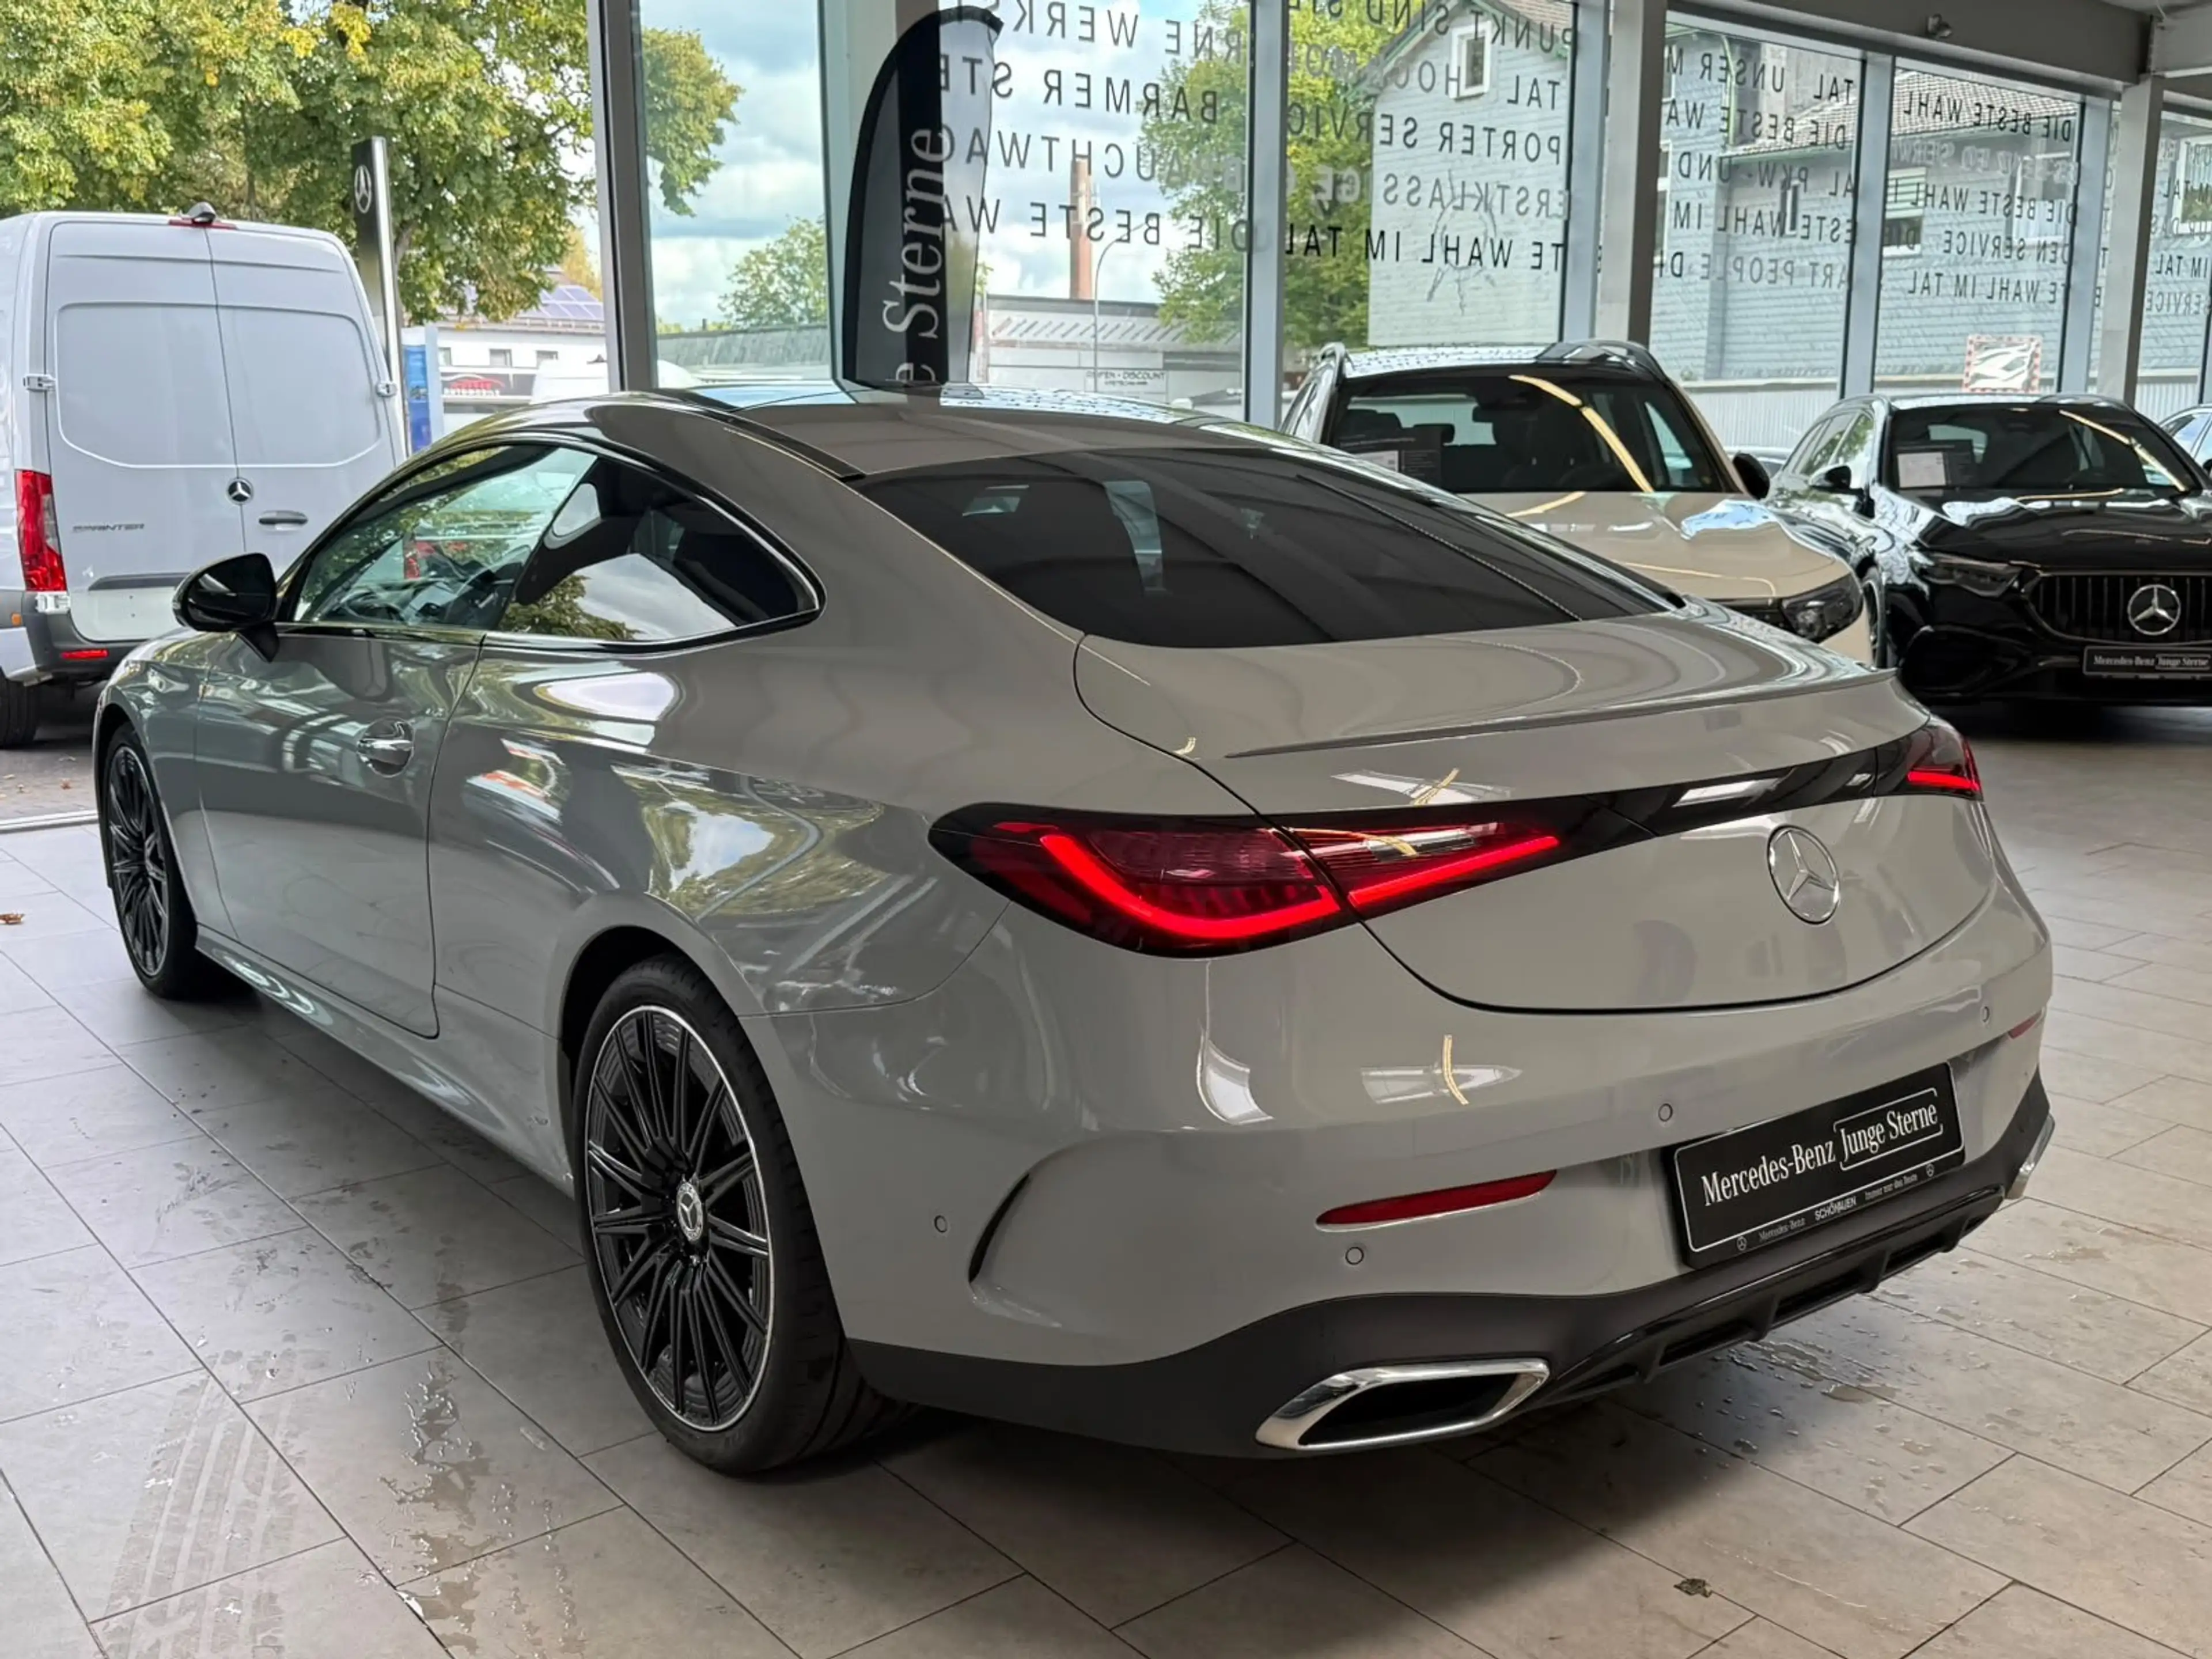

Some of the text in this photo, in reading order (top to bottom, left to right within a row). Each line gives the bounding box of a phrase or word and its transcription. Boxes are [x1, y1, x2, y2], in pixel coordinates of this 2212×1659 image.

[882, 128, 948, 339] Sterne
[1701, 1103, 1939, 1207] Mercedes-Benz Junge Sterne
